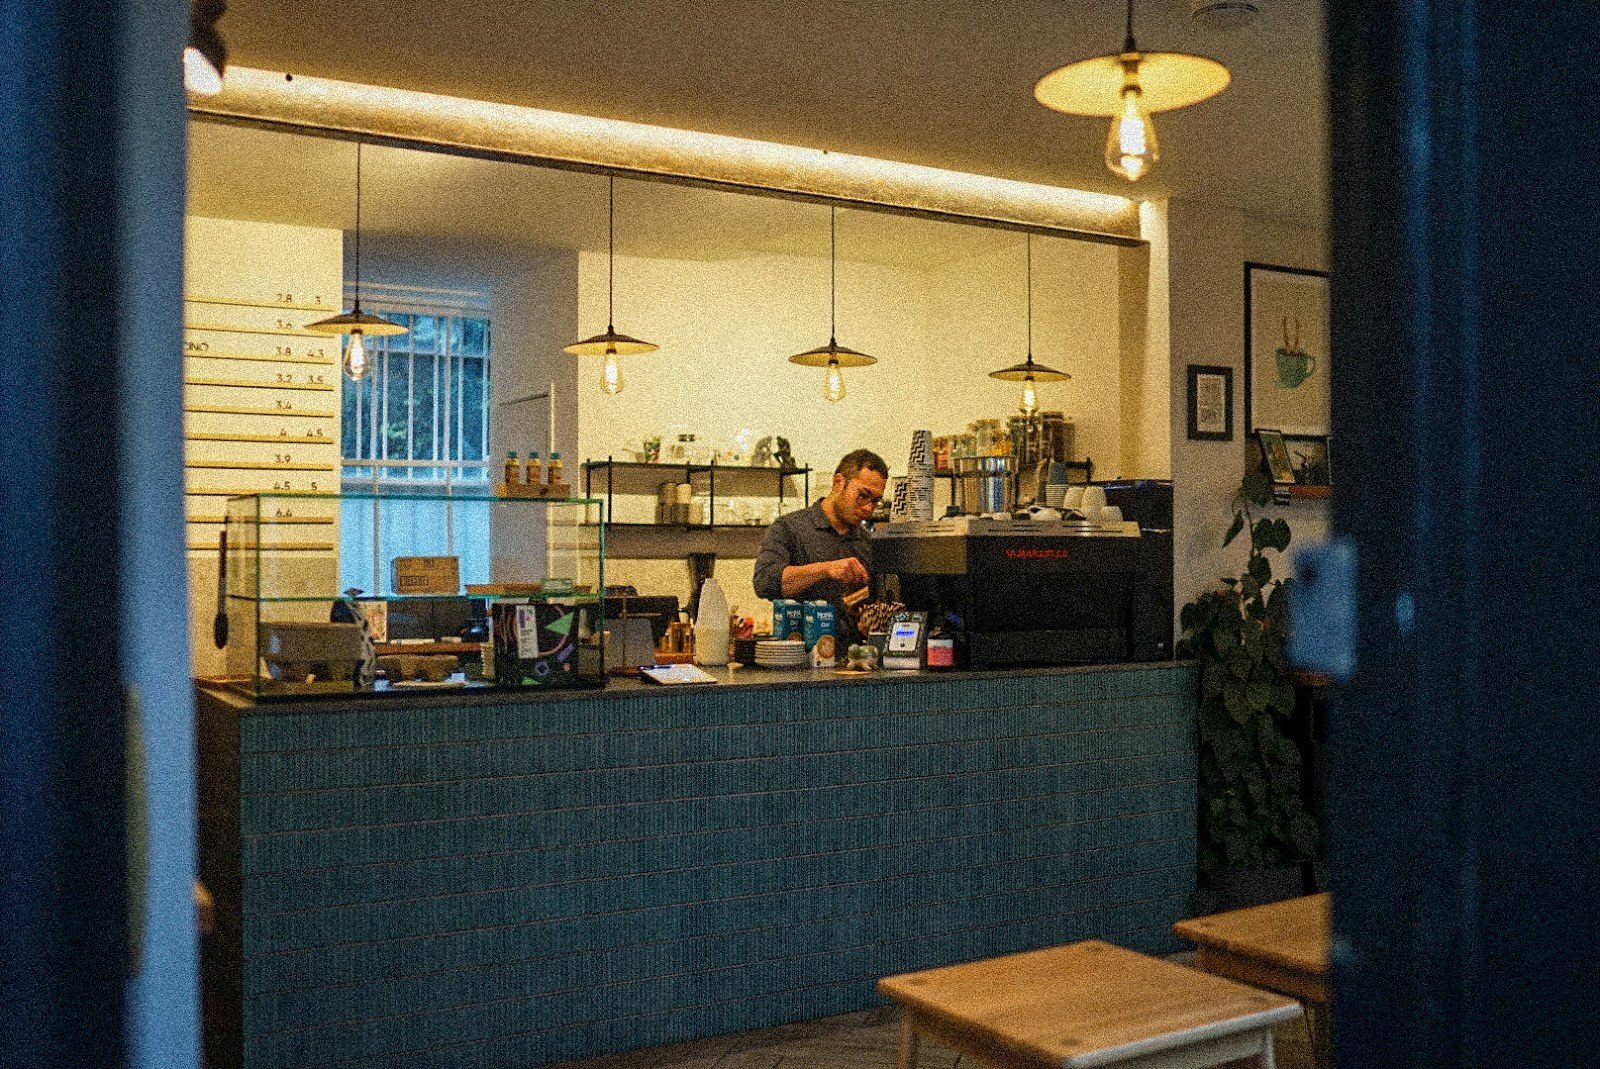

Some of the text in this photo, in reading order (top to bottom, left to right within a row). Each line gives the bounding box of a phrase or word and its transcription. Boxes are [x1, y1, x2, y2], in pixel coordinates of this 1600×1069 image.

[314, 295, 322, 305] 3
[275, 346, 292, 356] 3.8
[276, 400, 292, 410] 3.4
[279, 428, 323, 438] 4 4.5
[275, 454, 291, 464] 3.9
[274, 481, 318, 491] 4.5 5
